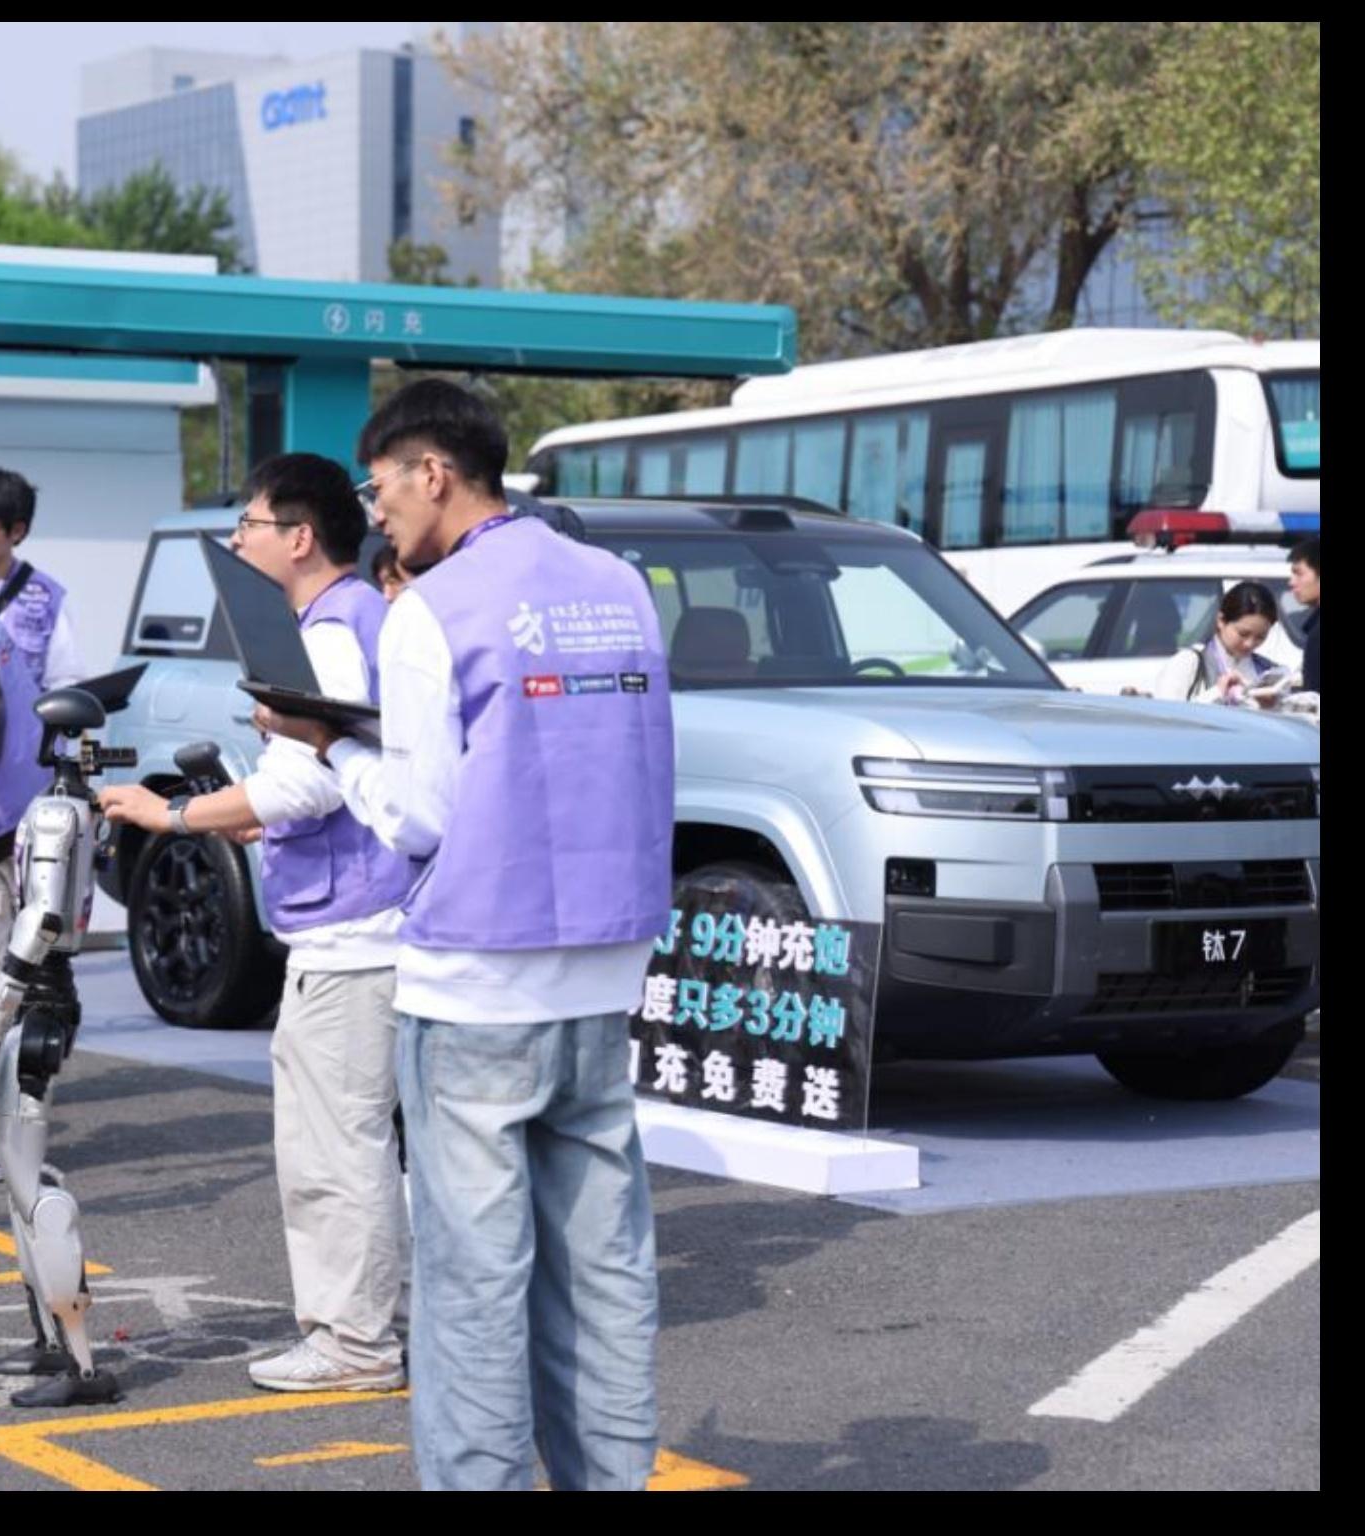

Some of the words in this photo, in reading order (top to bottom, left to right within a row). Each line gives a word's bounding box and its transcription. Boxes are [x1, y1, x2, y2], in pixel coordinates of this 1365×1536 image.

[690, 911, 852, 977] 9分钟充饱
[1201, 928, 1247, 963] 钛7
[628, 973, 846, 1049] 度只多3分钟
